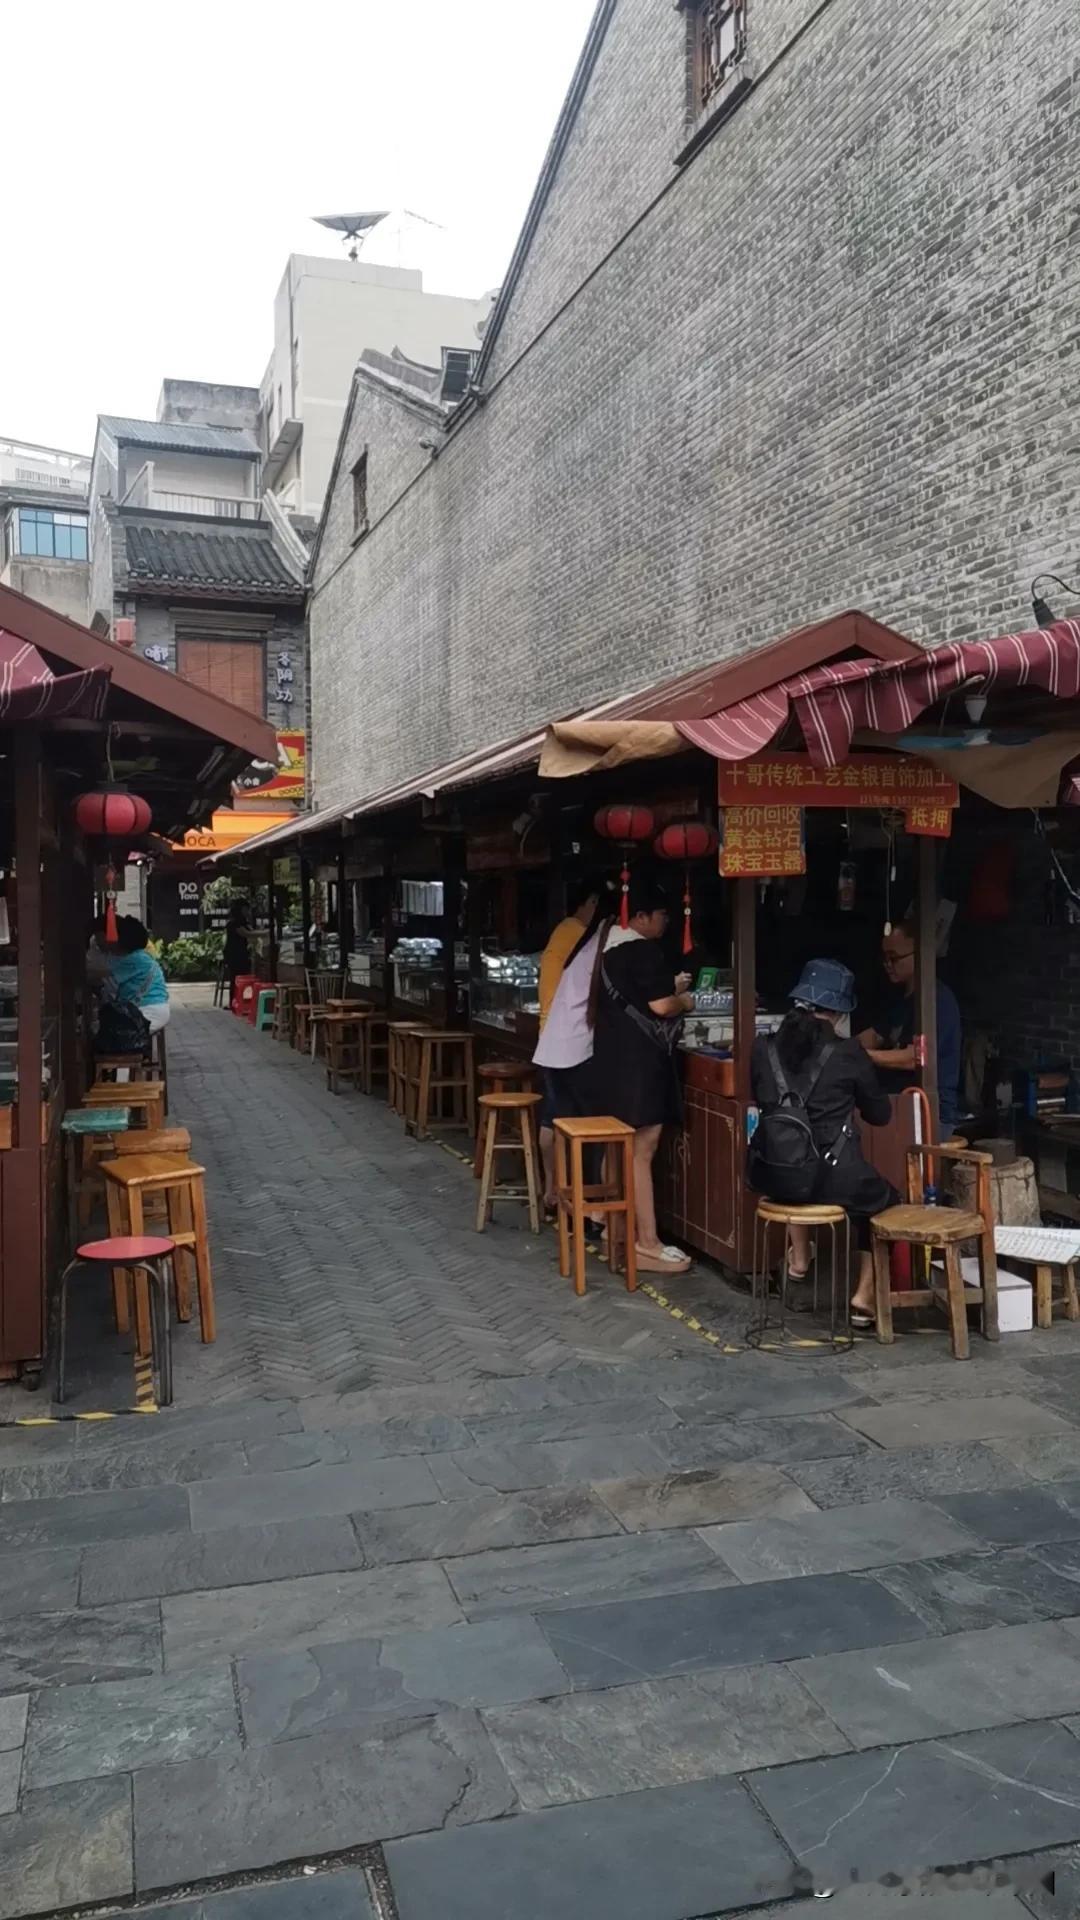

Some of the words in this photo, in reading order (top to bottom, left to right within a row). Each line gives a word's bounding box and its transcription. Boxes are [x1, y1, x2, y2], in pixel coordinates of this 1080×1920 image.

[726, 763, 952, 788] 十哥传统工艺金银首饰加工
[725, 807, 801, 826] 高价回收
[911, 807, 948, 829] 抵押
[725, 828, 801, 849] 黄金钻石
[724, 850, 801, 873] 珠宝玉器
